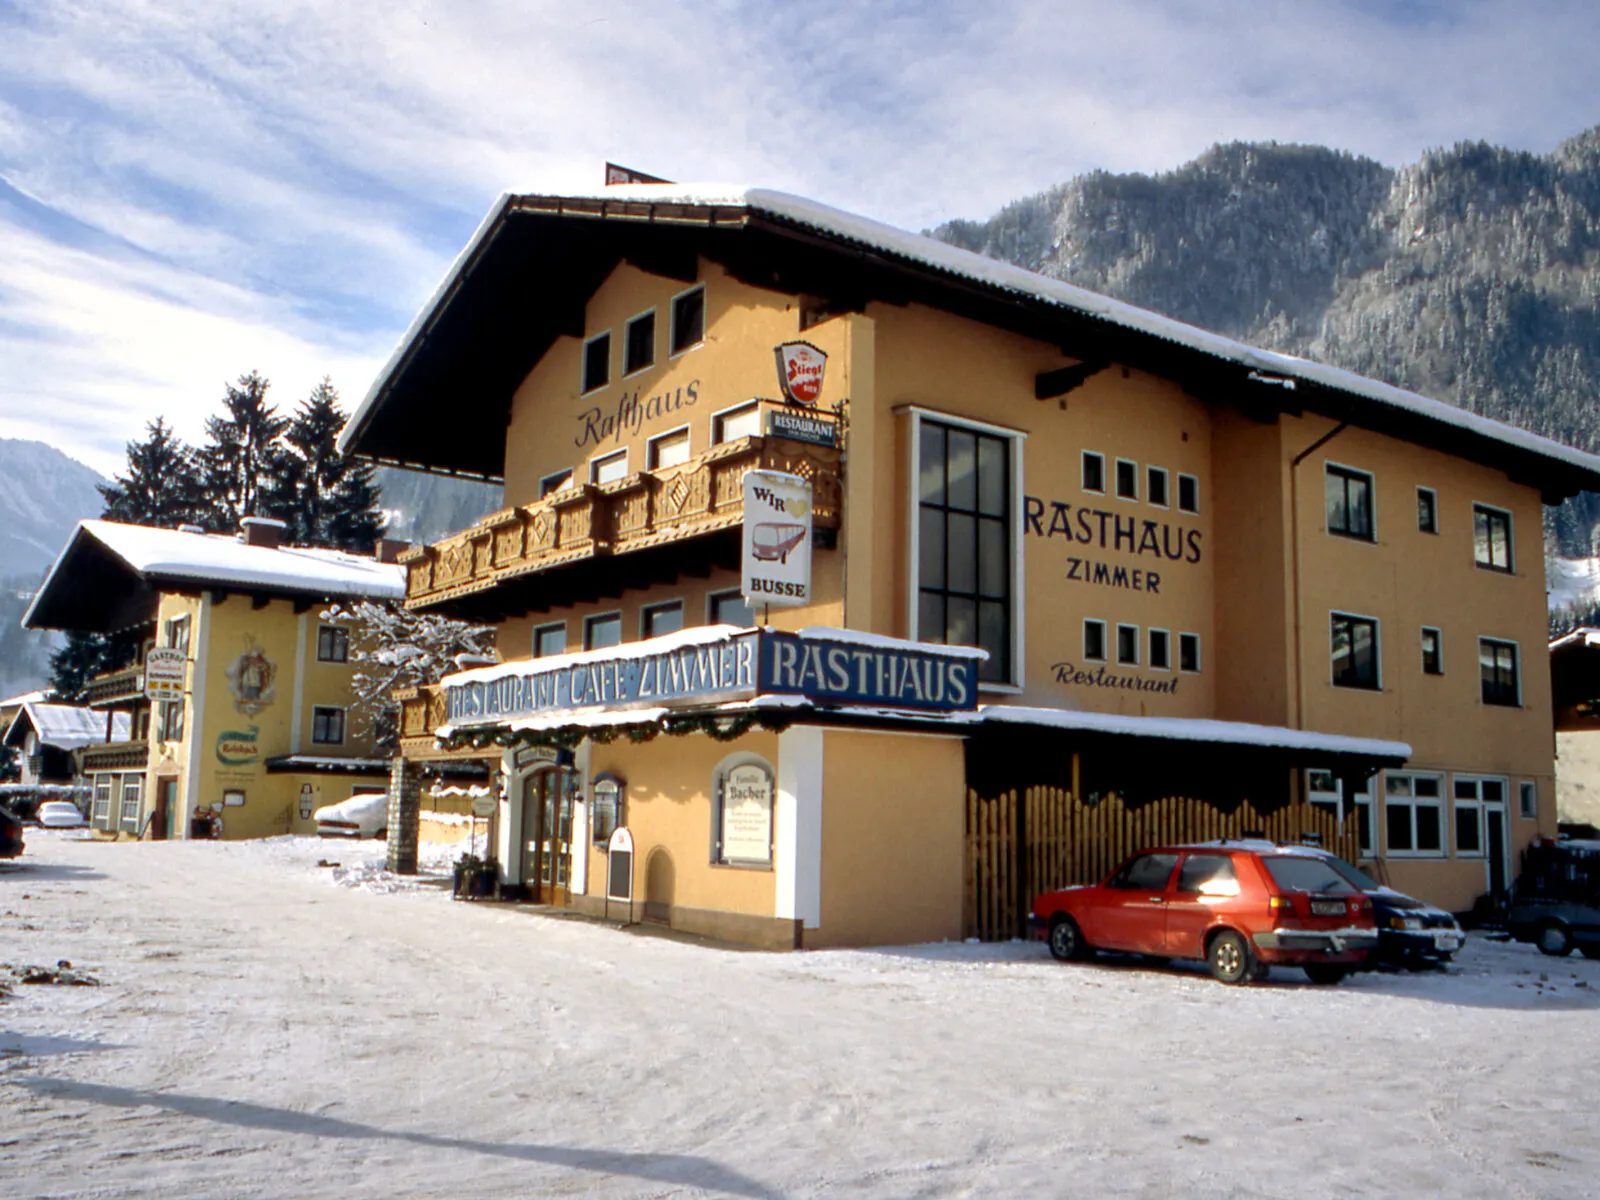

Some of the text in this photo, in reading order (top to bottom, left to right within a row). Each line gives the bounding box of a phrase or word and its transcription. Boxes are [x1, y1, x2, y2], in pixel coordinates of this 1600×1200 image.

[774, 415, 834, 438] RESTAURANT
[752, 486, 786, 512] WIR
[1023, 494, 1203, 564] RASTHAUS
[750, 577, 806, 598] BUSSE
[1066, 557, 1161, 594] ZIMMER
[451, 671, 561, 720] RESTAURANT
[637, 639, 753, 698] ZIMMER
[772, 640, 968, 705] RASTHAUS
[1051, 661, 1180, 695] Restaurant
